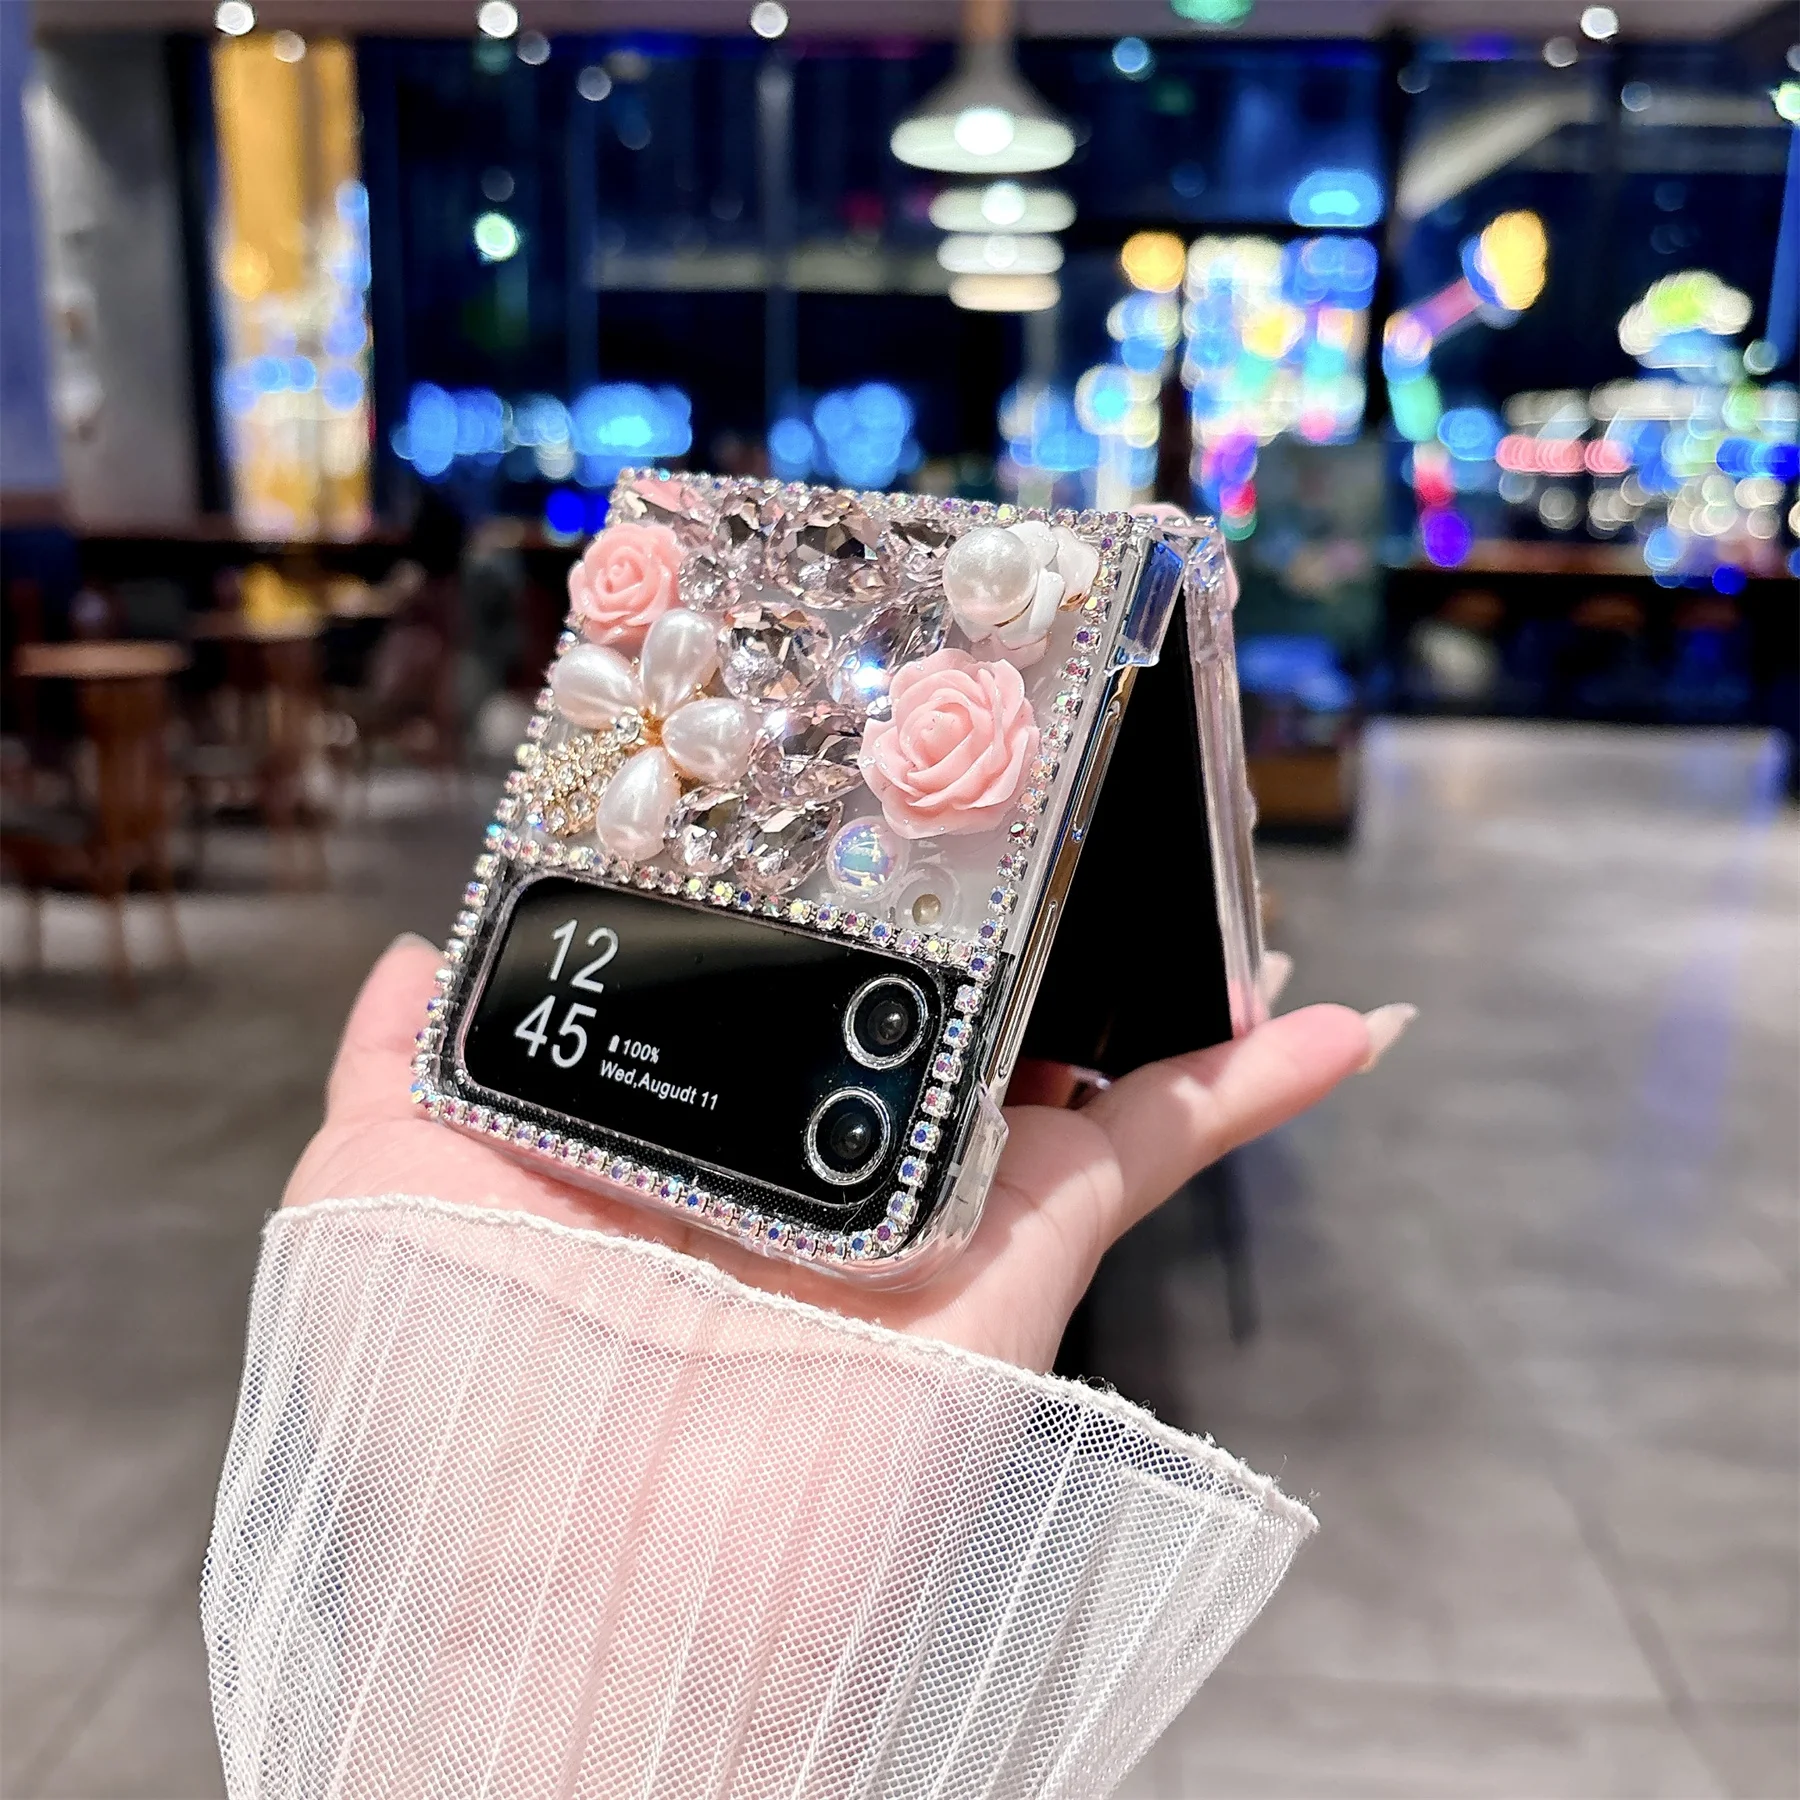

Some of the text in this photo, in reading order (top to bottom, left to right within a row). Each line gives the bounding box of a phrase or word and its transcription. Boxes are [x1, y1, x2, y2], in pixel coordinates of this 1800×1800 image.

[548, 918, 620, 993] 12
[514, 995, 597, 1069] 45
[622, 1039, 660, 1064] 100%
[701, 1091, 719, 1111] 11
